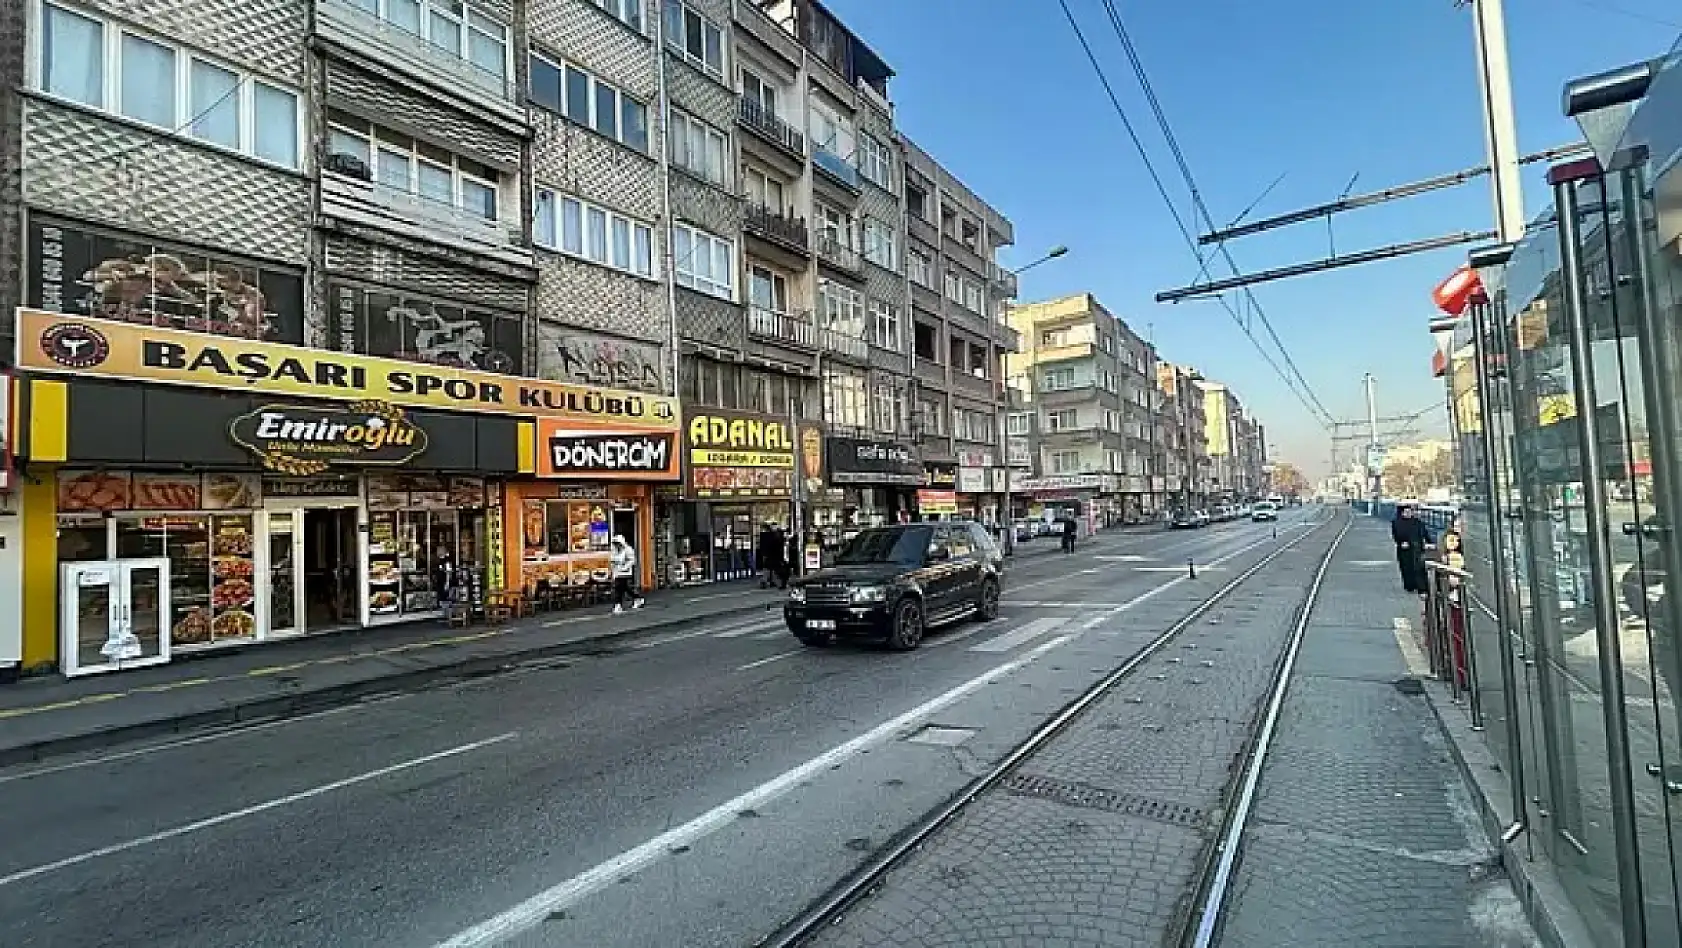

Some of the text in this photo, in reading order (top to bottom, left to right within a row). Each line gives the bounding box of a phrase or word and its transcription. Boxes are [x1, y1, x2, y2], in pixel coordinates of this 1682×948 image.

[143, 340, 366, 389] BAŞARI
[387, 372, 503, 403] SPOR
[519, 385, 645, 417] KULÜBÜ
